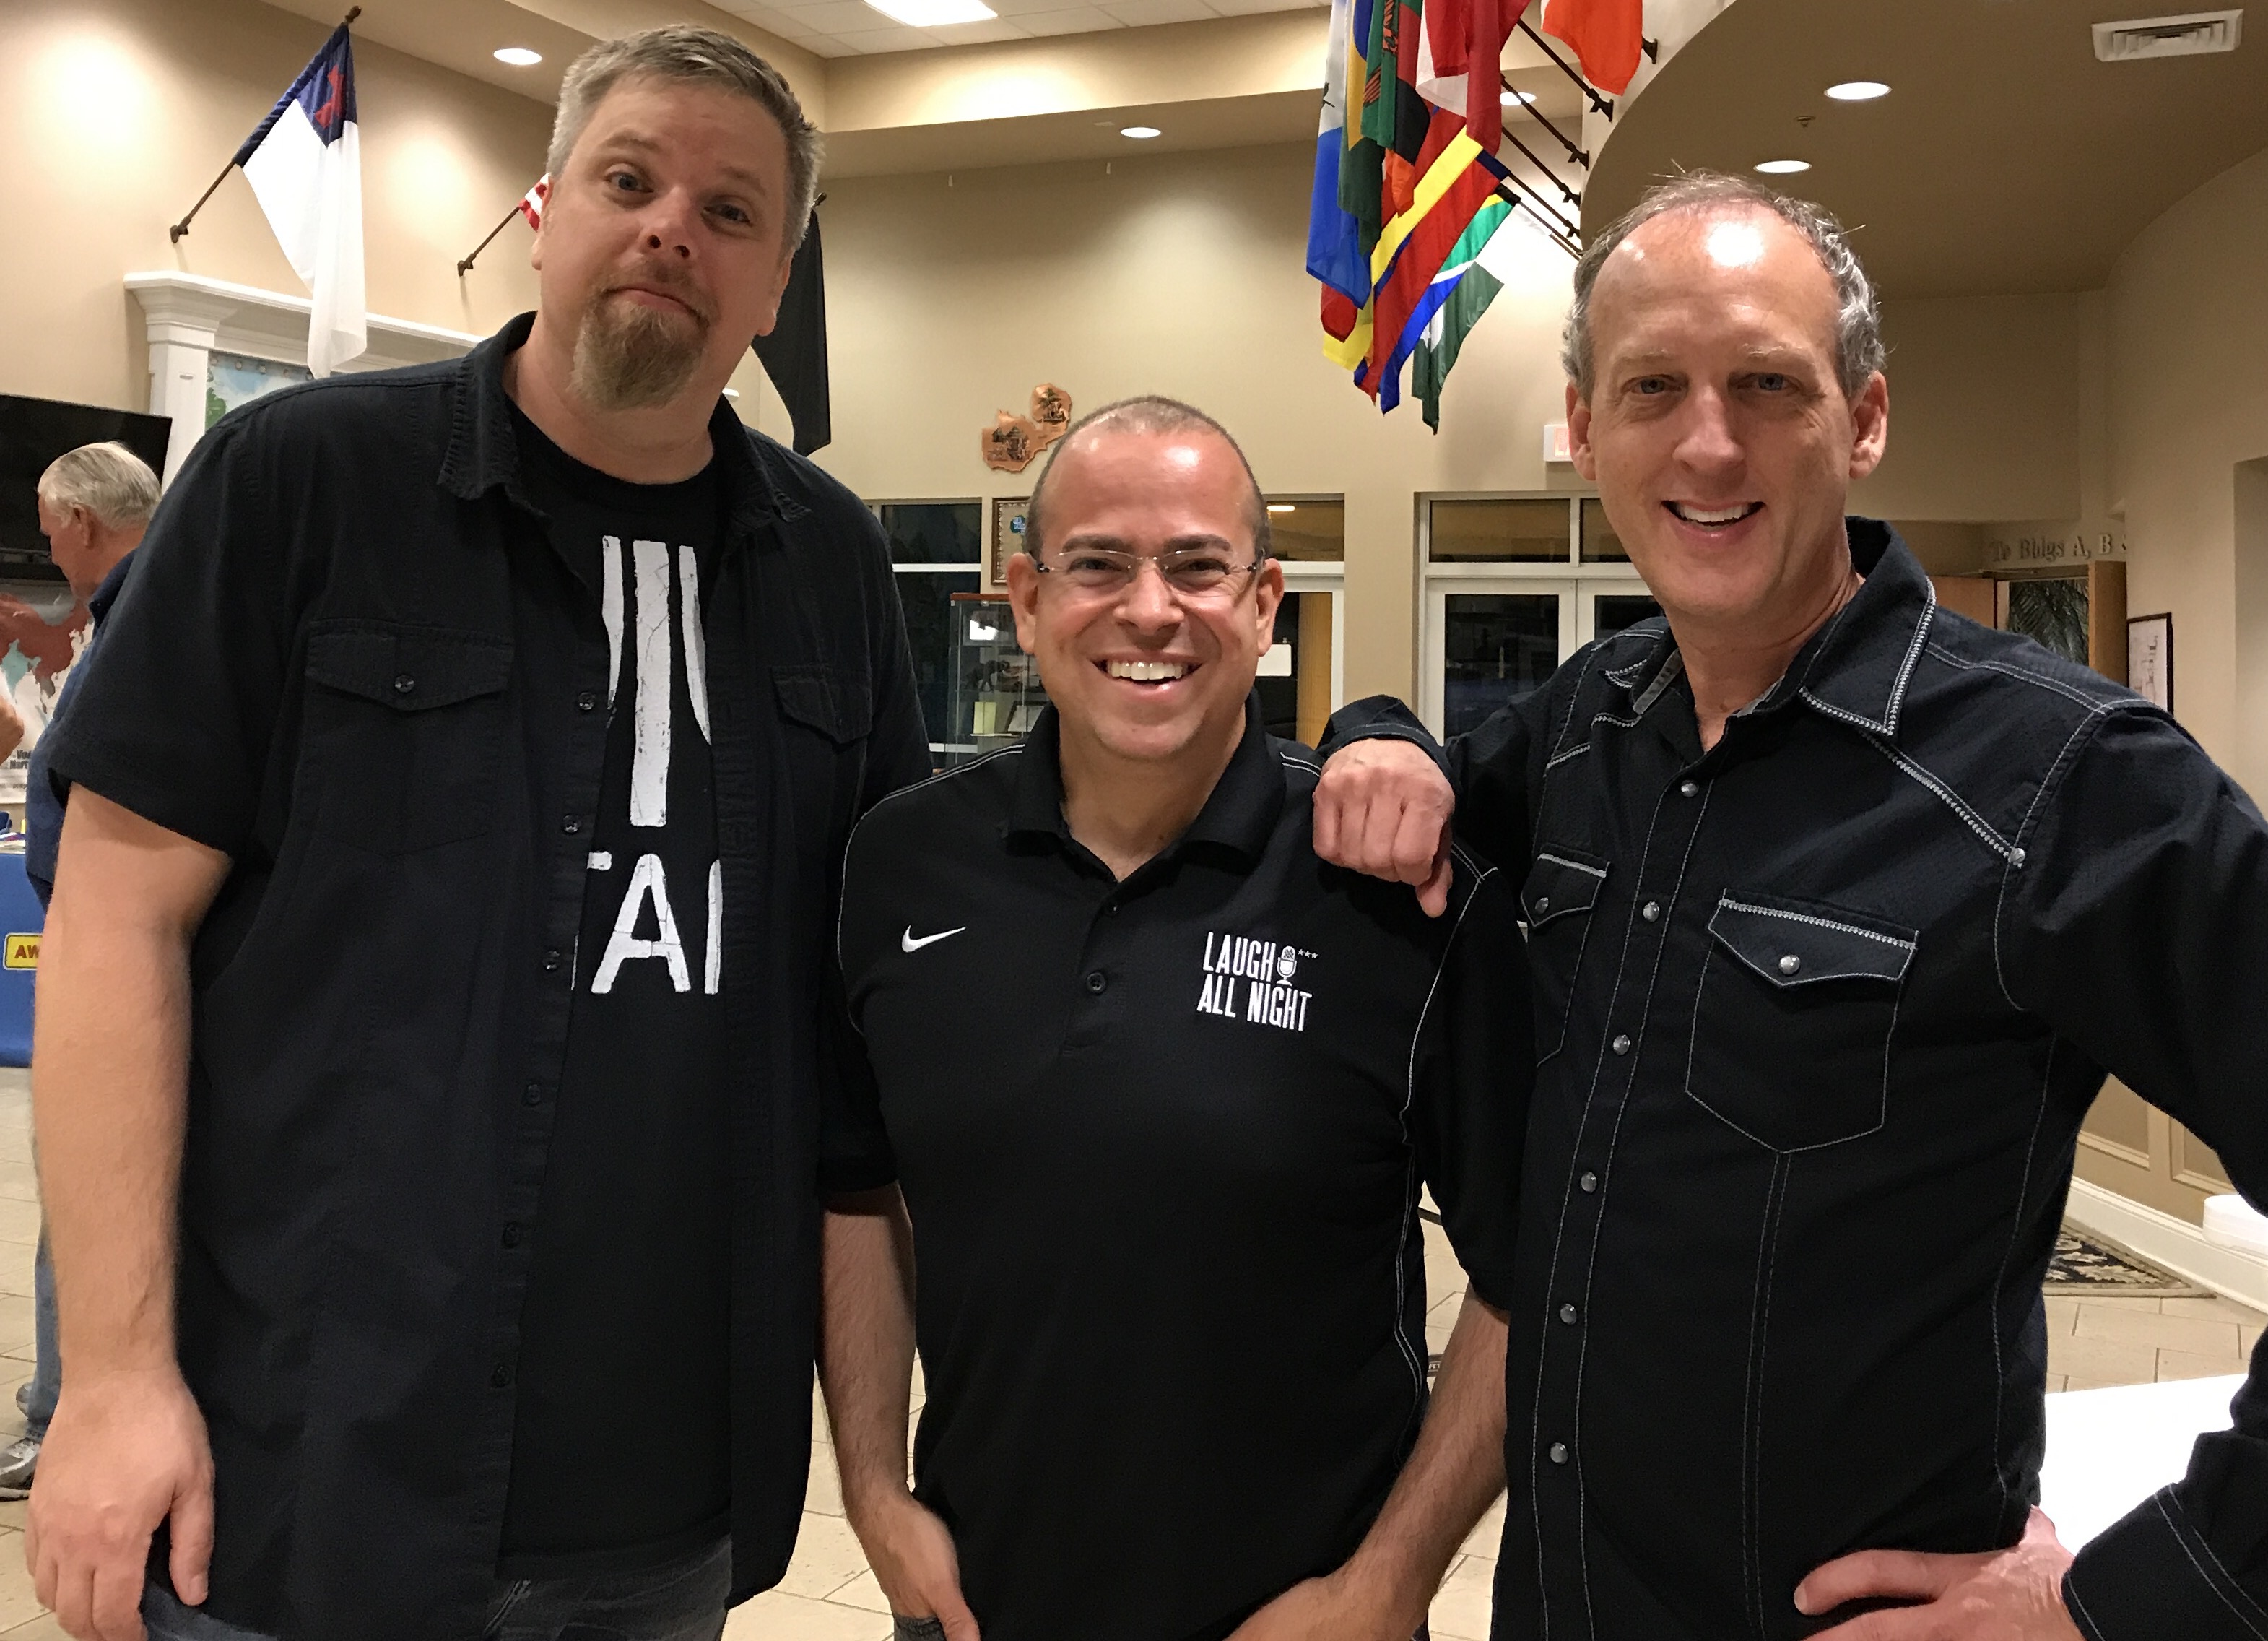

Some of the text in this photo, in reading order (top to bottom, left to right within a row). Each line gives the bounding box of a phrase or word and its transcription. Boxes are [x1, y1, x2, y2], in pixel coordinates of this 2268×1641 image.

[2020, 537, 2065, 563] Bldgs
[2073, 535, 2092, 559] A,
[2098, 533, 2112, 555] B
[1202, 932, 1276, 982] LAUGH
[1196, 974, 1313, 1031] ALL NIGHT
